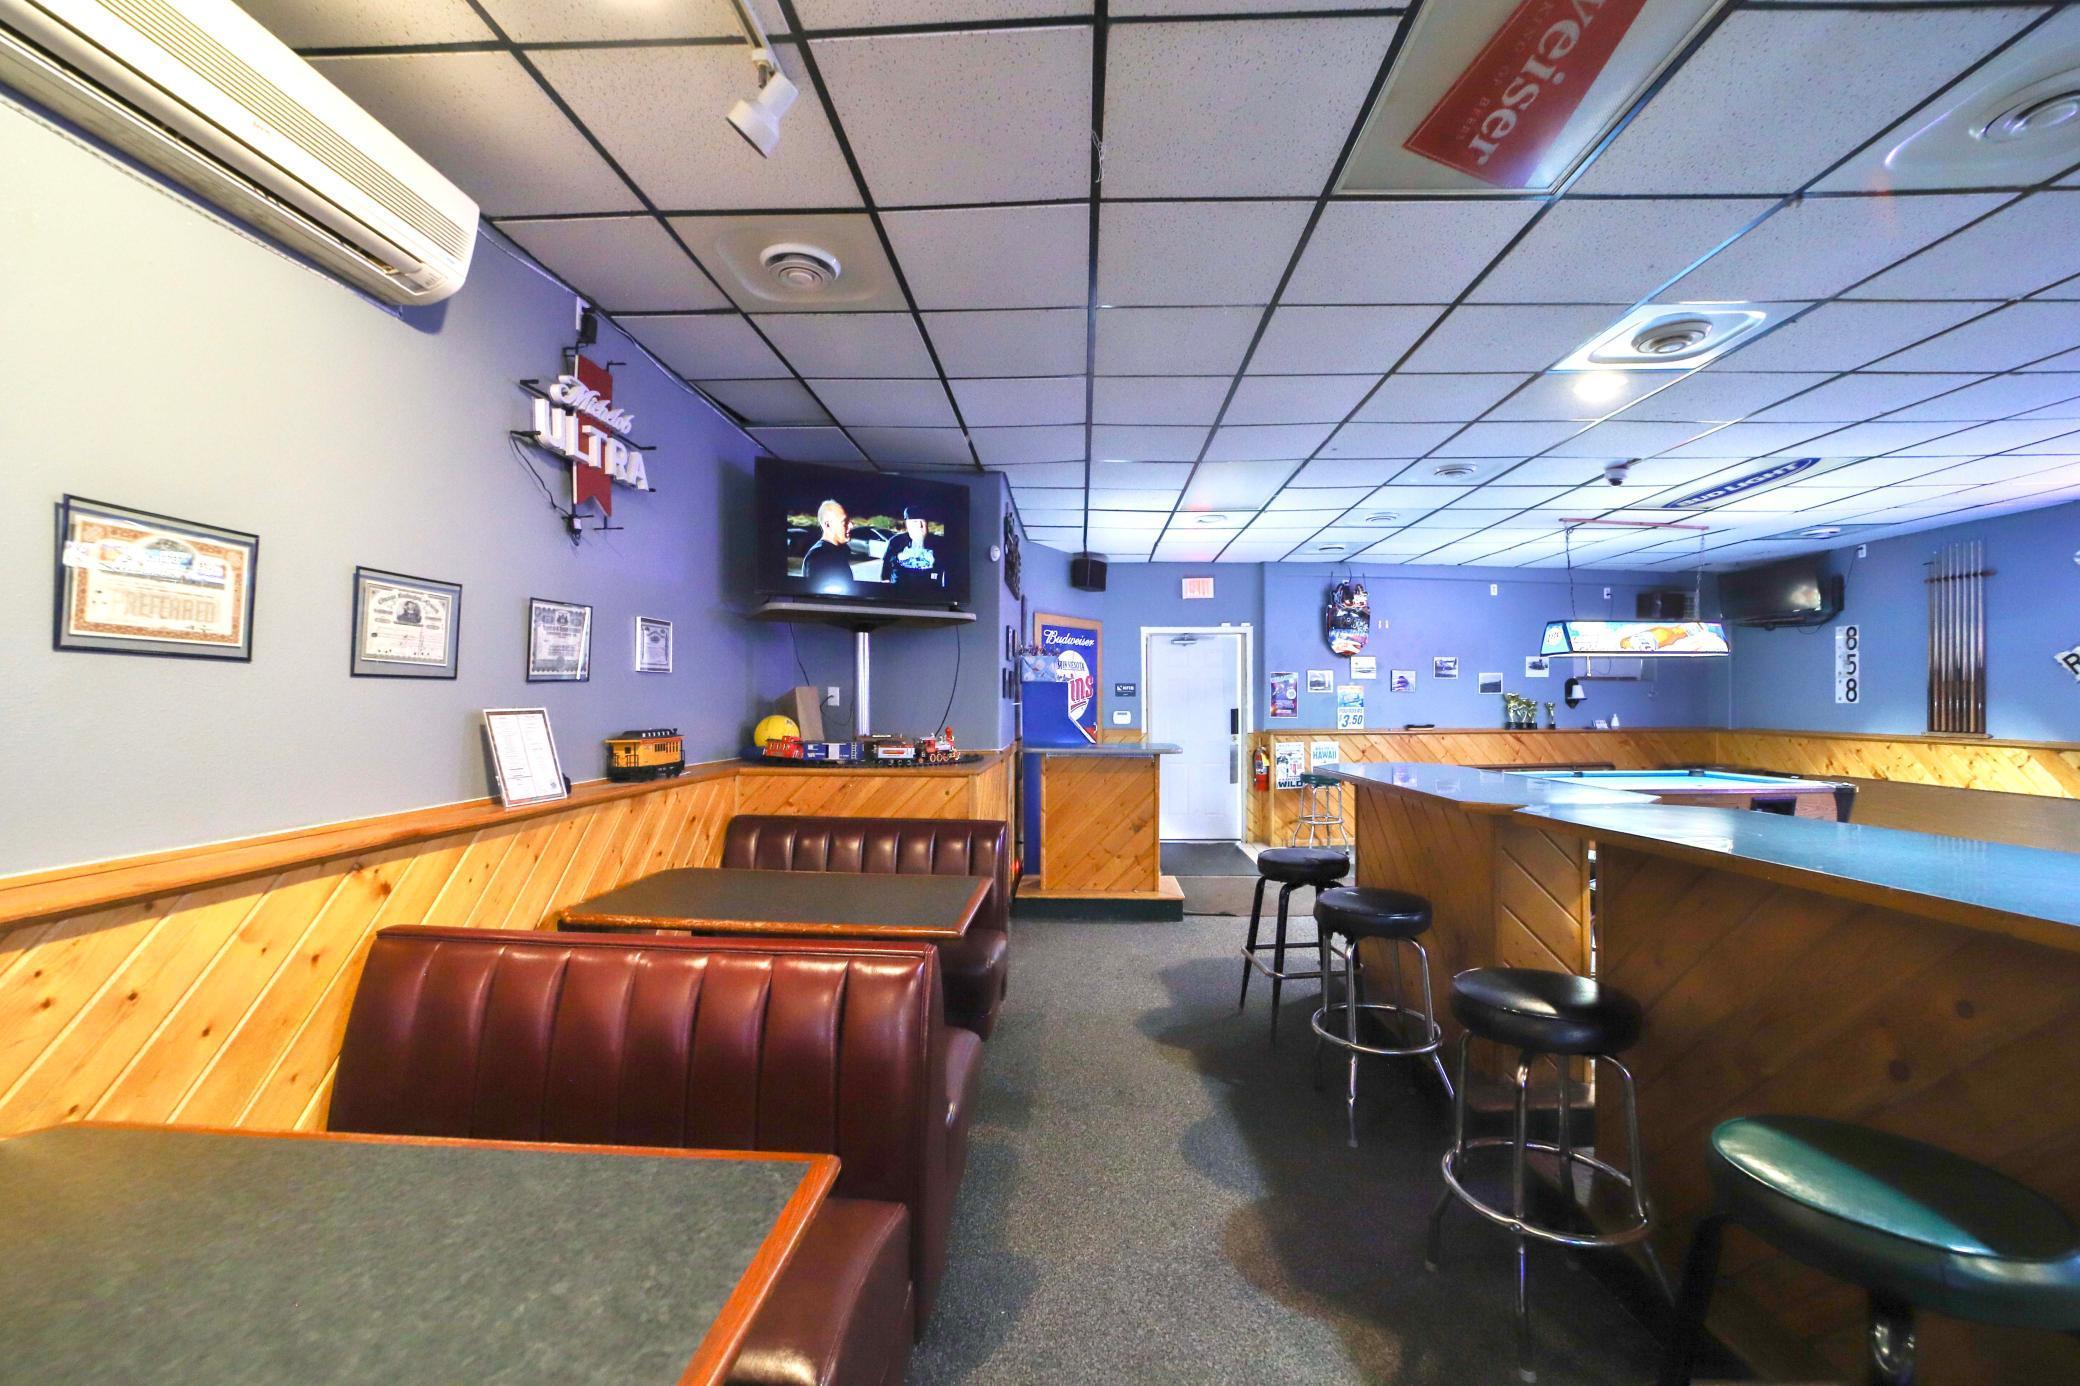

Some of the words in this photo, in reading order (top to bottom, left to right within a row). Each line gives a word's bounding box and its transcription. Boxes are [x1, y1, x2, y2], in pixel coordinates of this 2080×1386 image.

[534, 397, 649, 491] ULTRA
[1676, 489, 1726, 507] BUD
[1724, 461, 1799, 491] LIGHT
[1043, 629, 1095, 647] Budweiser
[1069, 675, 1094, 703] ins
[1312, 750, 1337, 760] HAWAII
[1278, 780, 1304, 788] WILD
